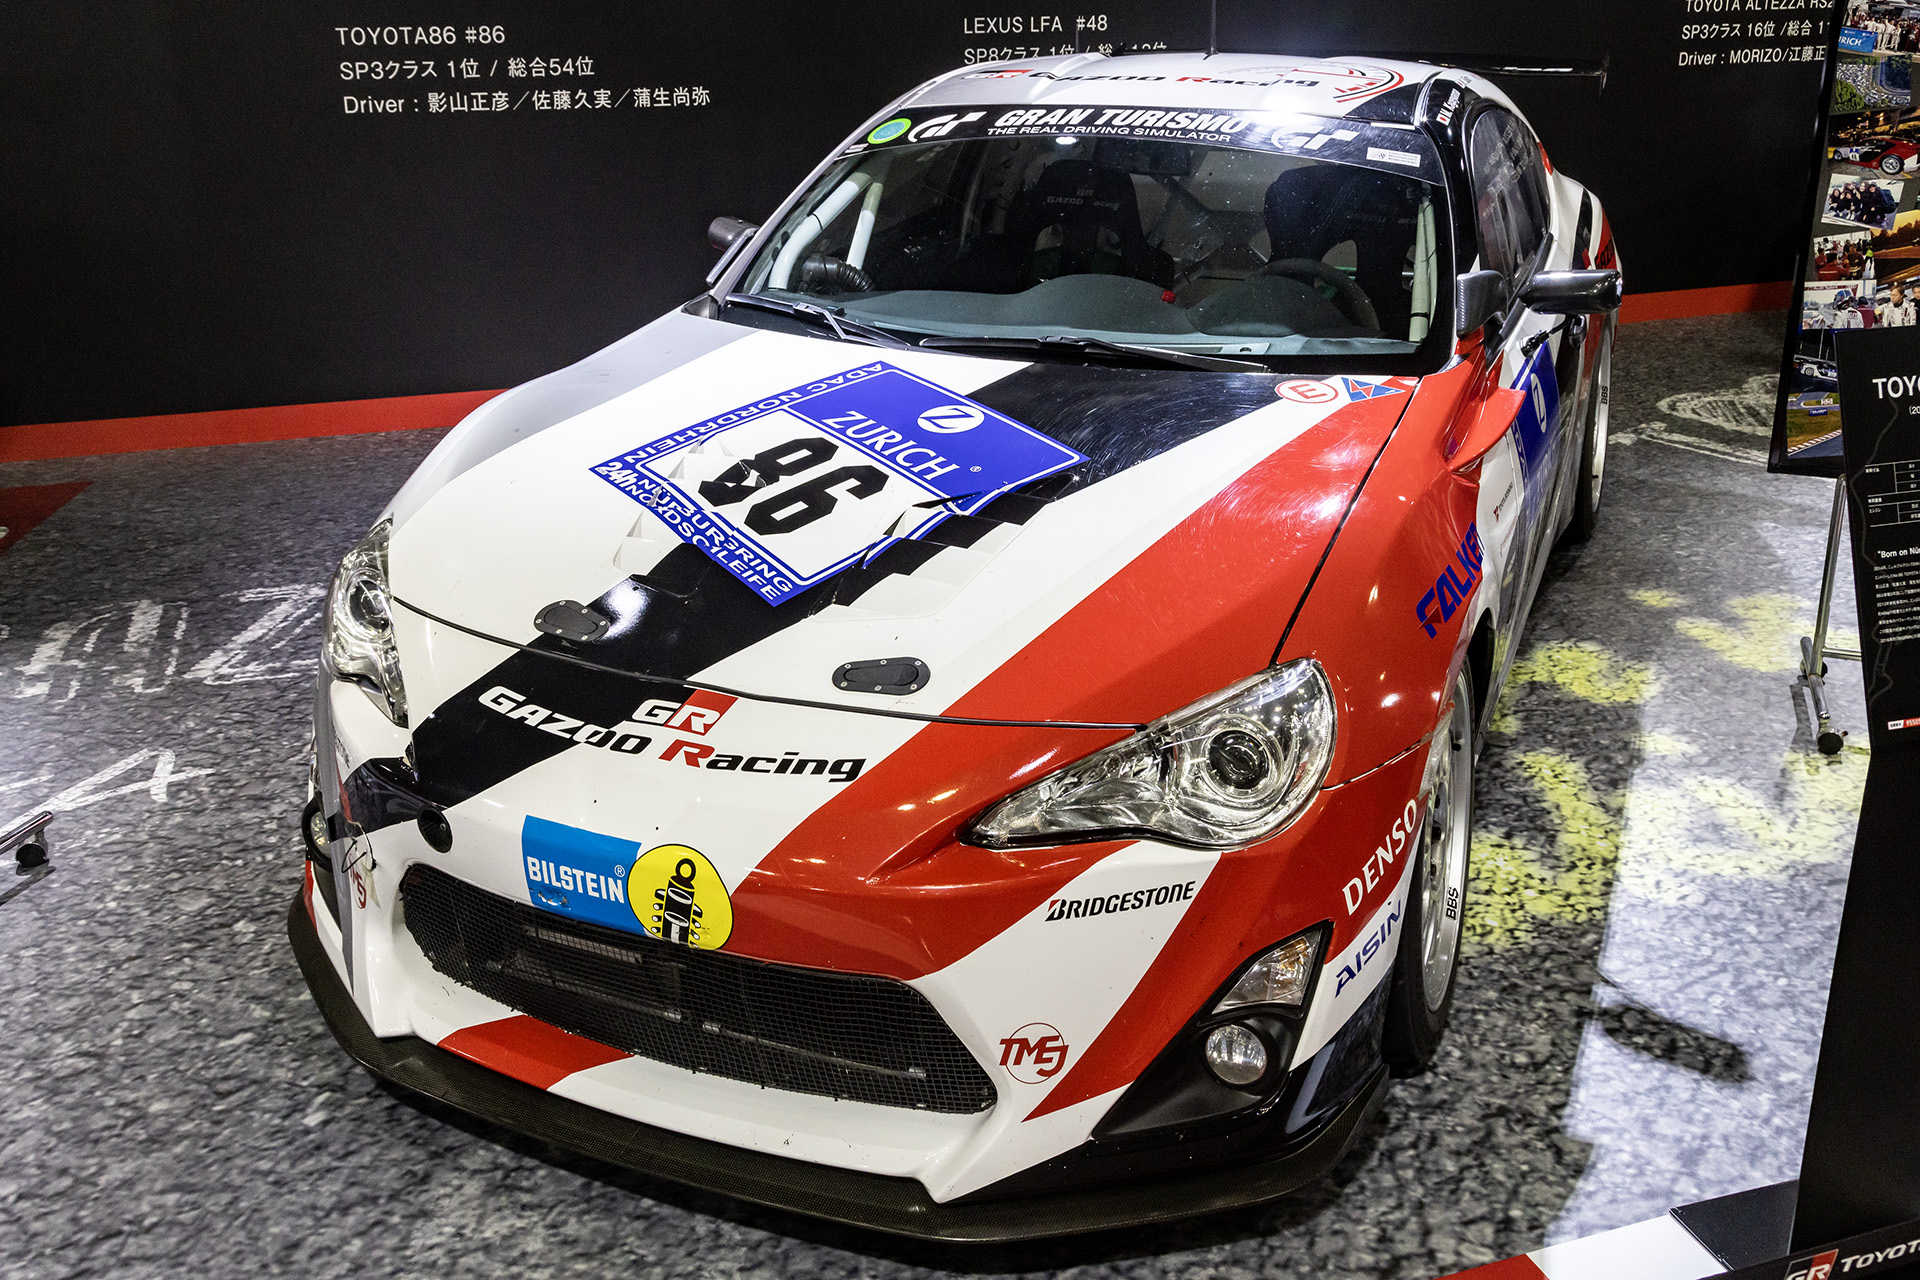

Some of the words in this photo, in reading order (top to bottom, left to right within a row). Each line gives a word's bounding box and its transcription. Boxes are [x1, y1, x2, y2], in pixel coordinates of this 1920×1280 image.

[335, 26, 457, 46] TOYOTA86
[465, 25, 506, 44] #86
[964, 15, 1024, 34] LEXUS
[1030, 15, 1063, 33] LFA
[1076, 14, 1109, 32] #48
[1681, 22, 1741, 40] SP3クラス
[1747, 20, 1775, 38] 16位
[340, 60, 438, 81] SP3クラス
[448, 57, 481, 79] 1位
[508, 56, 596, 78] 総合54位
[1678, 51, 1717, 66] Driver
[343, 95, 405, 114] Driver
[995, 109, 1096, 127] GRAN
[1098, 109, 1252, 134] TURISMO
[987, 128, 1017, 136] THE
[1018, 126, 1060, 135] REAL
[1063, 126, 1130, 136] DRIVING
[1132, 126, 1232, 142] SIMULATOR
[807, 362, 882, 393] ADAC
[1872, 374, 1920, 399] TOY
[1600, 385, 1609, 405] BBS
[623, 391, 803, 464] NORDRHEIN
[821, 410, 961, 481] ZURICH
[697, 437, 890, 536] 86
[1416, 520, 1485, 640] FALKE
[631, 698, 721, 734] GR
[478, 686, 653, 755] GAZOO
[658, 738, 867, 783] Racing
[1342, 798, 1417, 916] DENSO
[526, 856, 625, 905] BILSTEIN
[1045, 880, 1197, 922] BRIDGESTONE
[1445, 886, 1460, 921] BBS
[1335, 898, 1402, 999] AISIN
[1840, 1239, 1920, 1273] TOYOT
